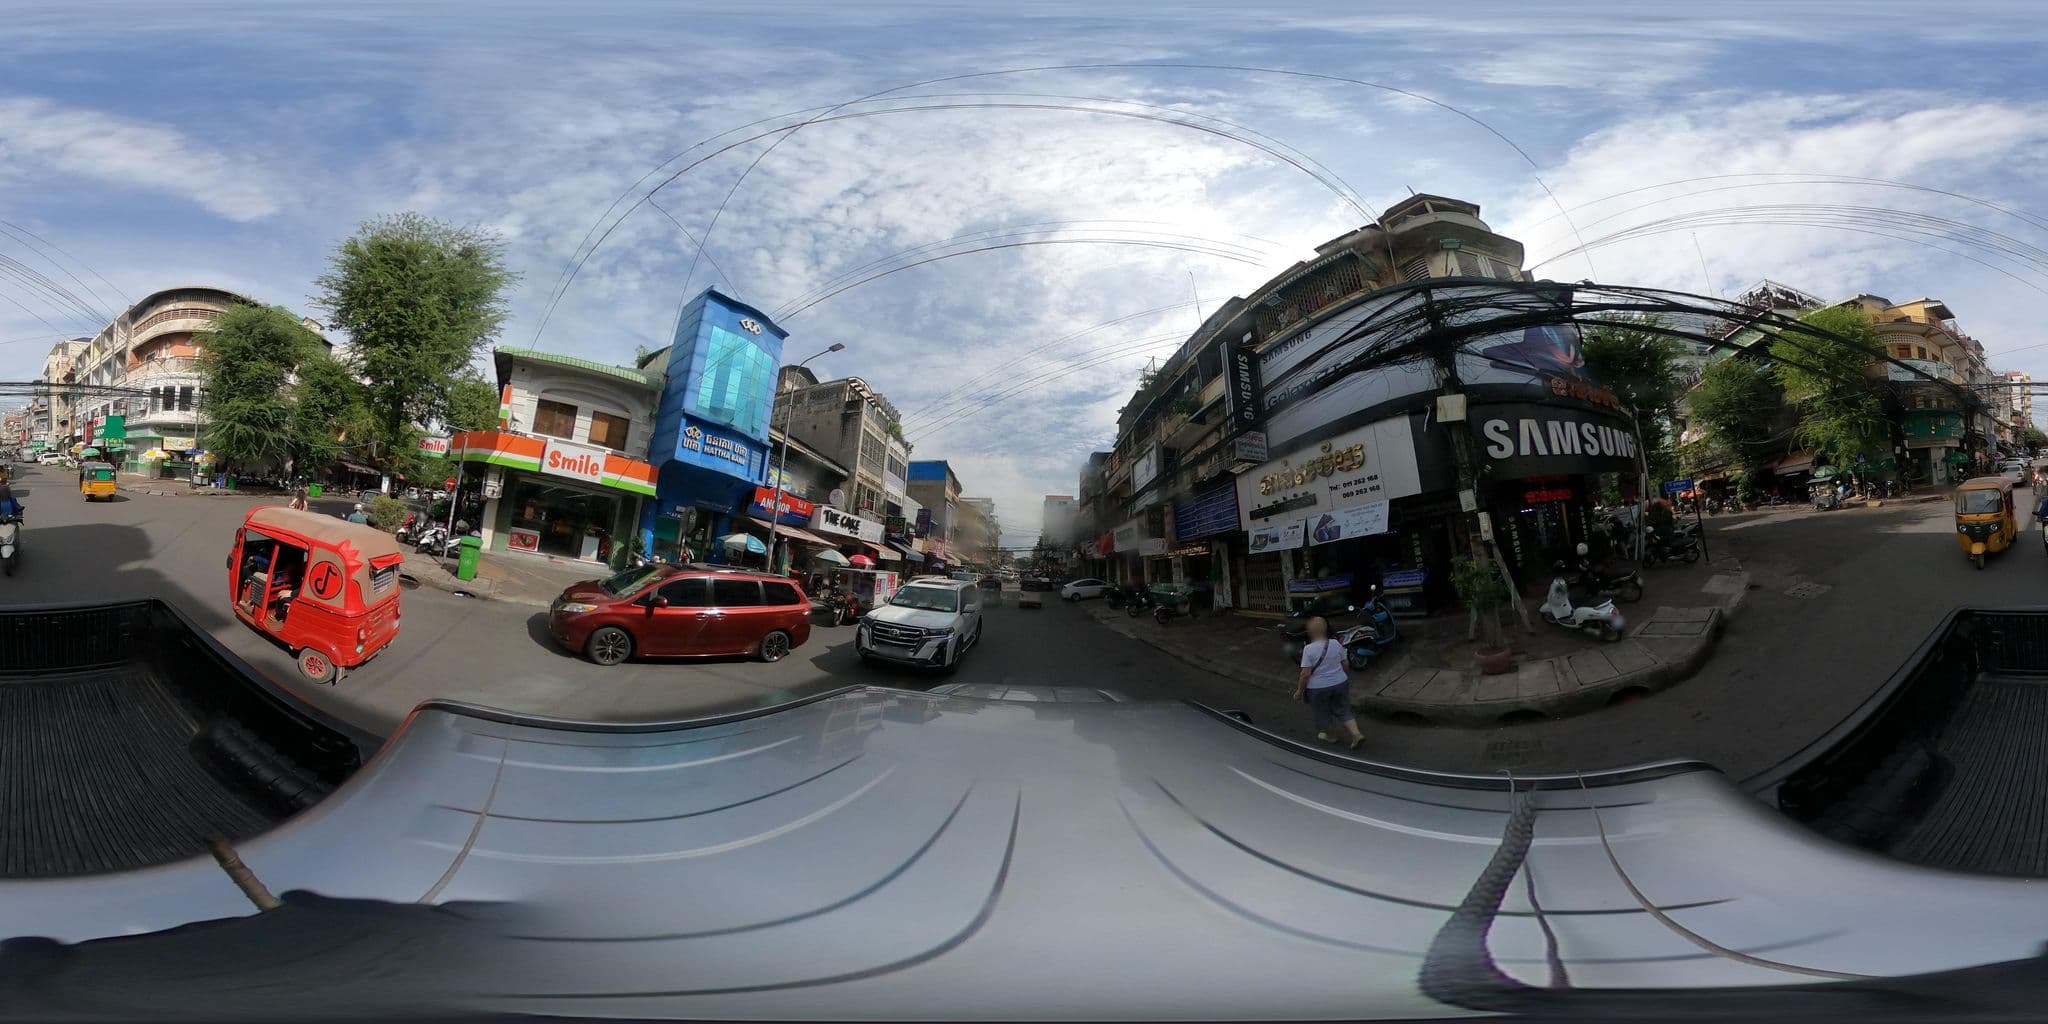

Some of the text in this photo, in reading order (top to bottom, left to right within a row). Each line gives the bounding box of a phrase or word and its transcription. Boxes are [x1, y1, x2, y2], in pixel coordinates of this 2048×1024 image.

[1263, 331, 1311, 364] SAMSUNG
[419, 439, 445, 452] Smile
[1483, 418, 1635, 460] SAMSUNG
[548, 450, 600, 476] Smile
[823, 509, 840, 526] THE
[840, 515, 861, 532] CAKE
